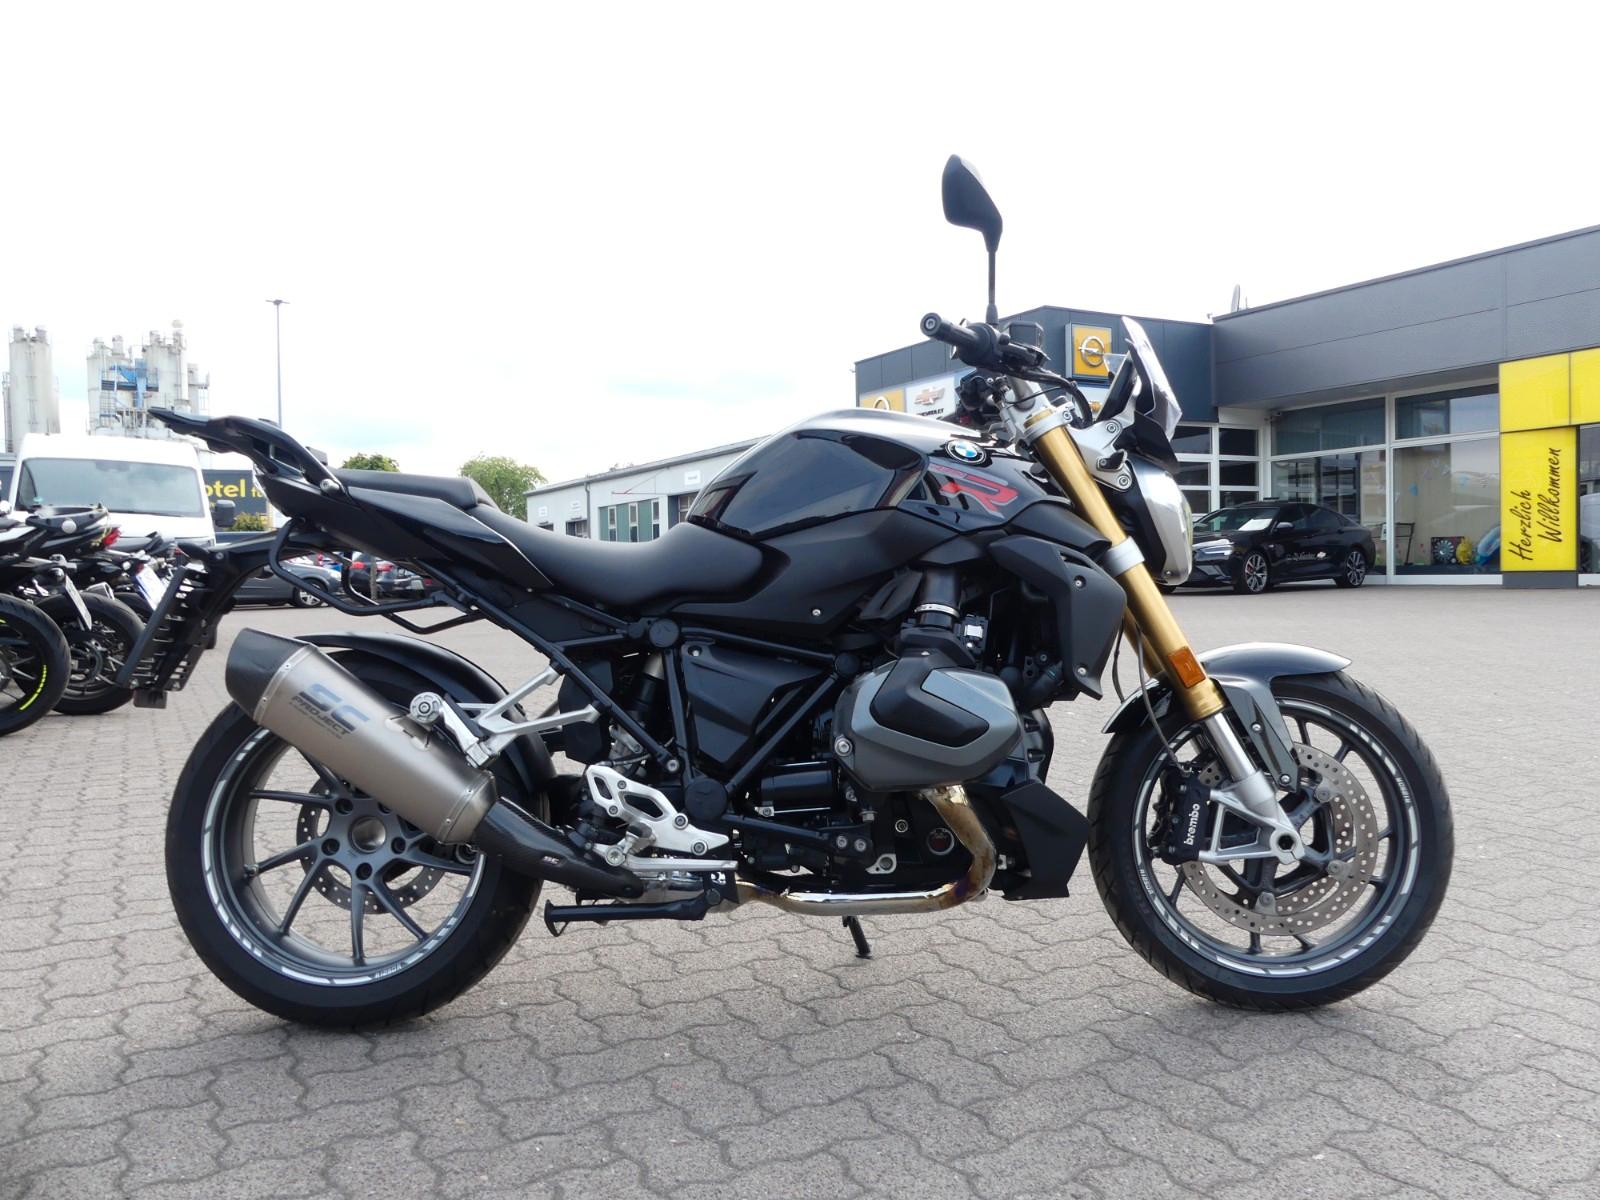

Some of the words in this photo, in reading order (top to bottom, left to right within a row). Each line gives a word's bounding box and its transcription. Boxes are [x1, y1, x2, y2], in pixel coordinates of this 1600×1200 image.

[204, 479, 246, 498] otel
[1537, 447, 1562, 543] Willkommen
[1508, 489, 1534, 561] Herzlich
[291, 695, 353, 735] PROJECT
[1184, 804, 1200, 846] brembo
